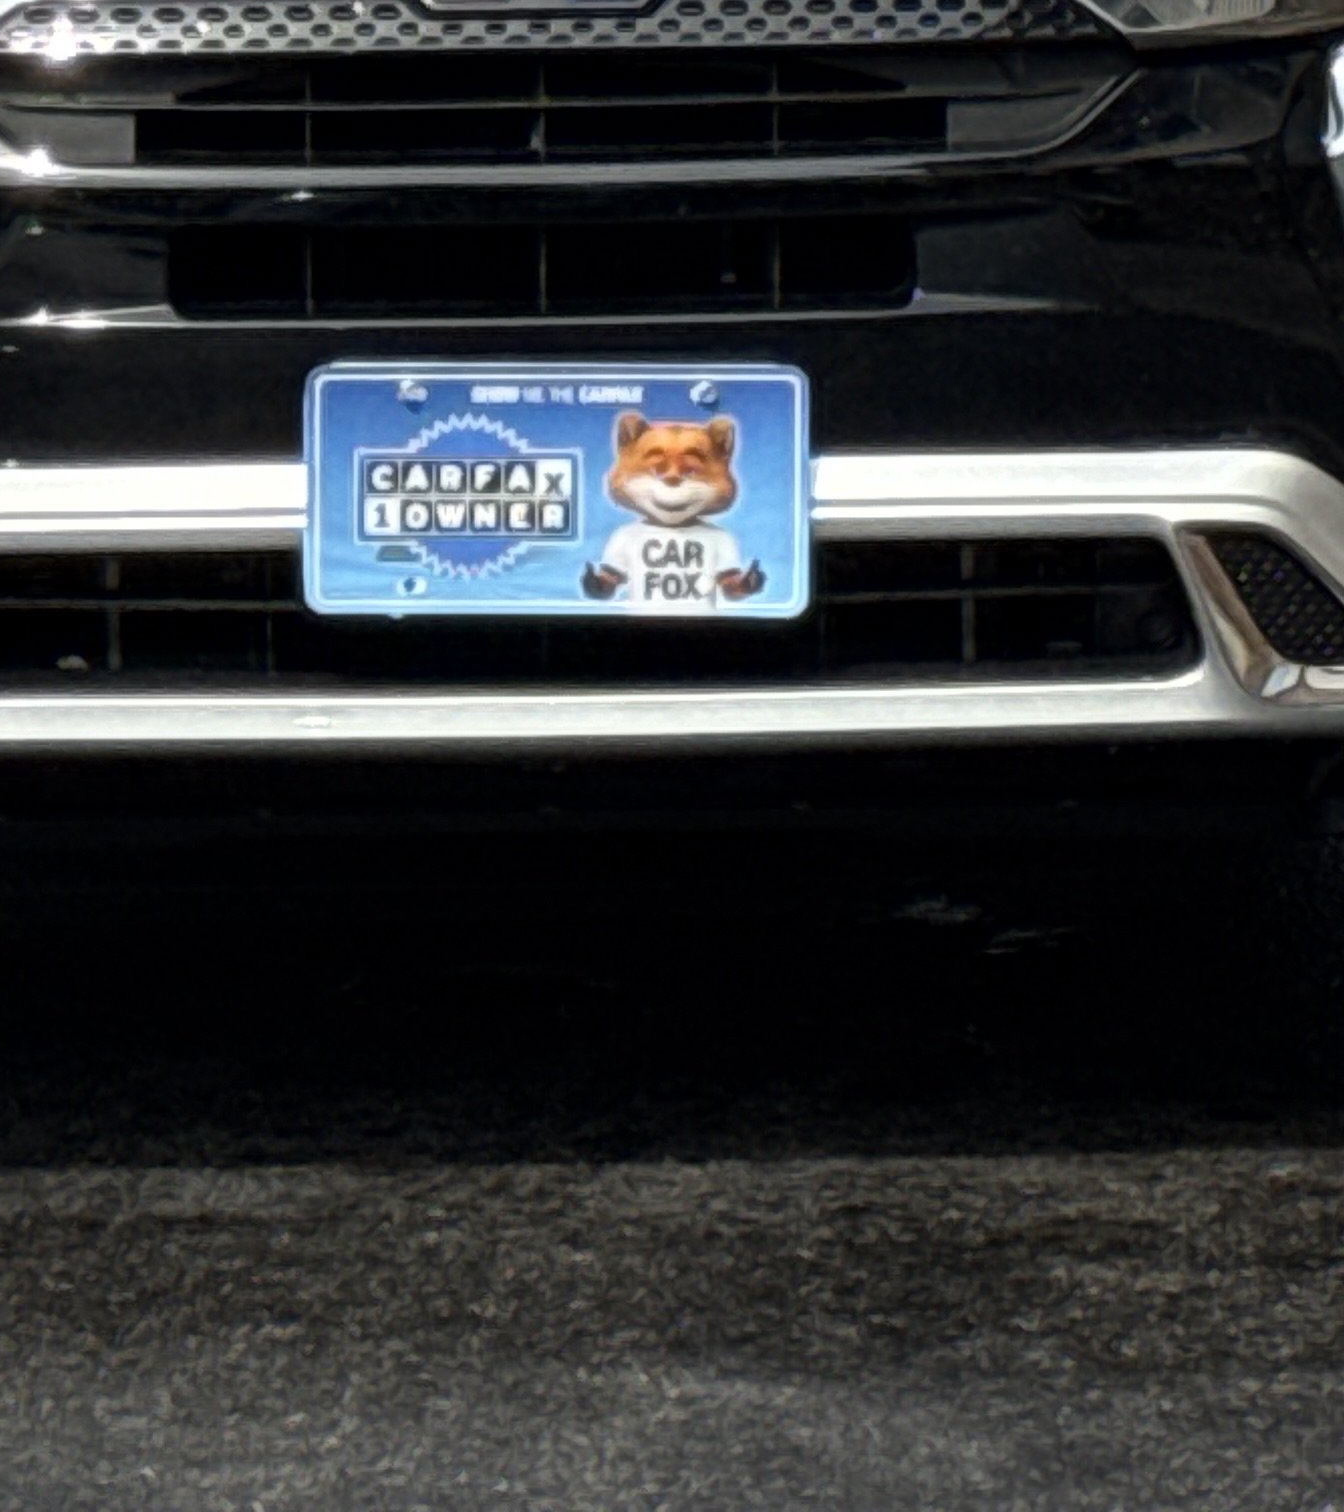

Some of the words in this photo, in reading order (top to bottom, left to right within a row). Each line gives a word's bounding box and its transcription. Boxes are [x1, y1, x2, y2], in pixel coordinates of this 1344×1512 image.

[371, 464, 565, 497] CARFAX
[374, 503, 390, 528] 1
[406, 502, 565, 530] OWNER
[642, 539, 704, 568] CAR
[644, 571, 704, 601] FOX
